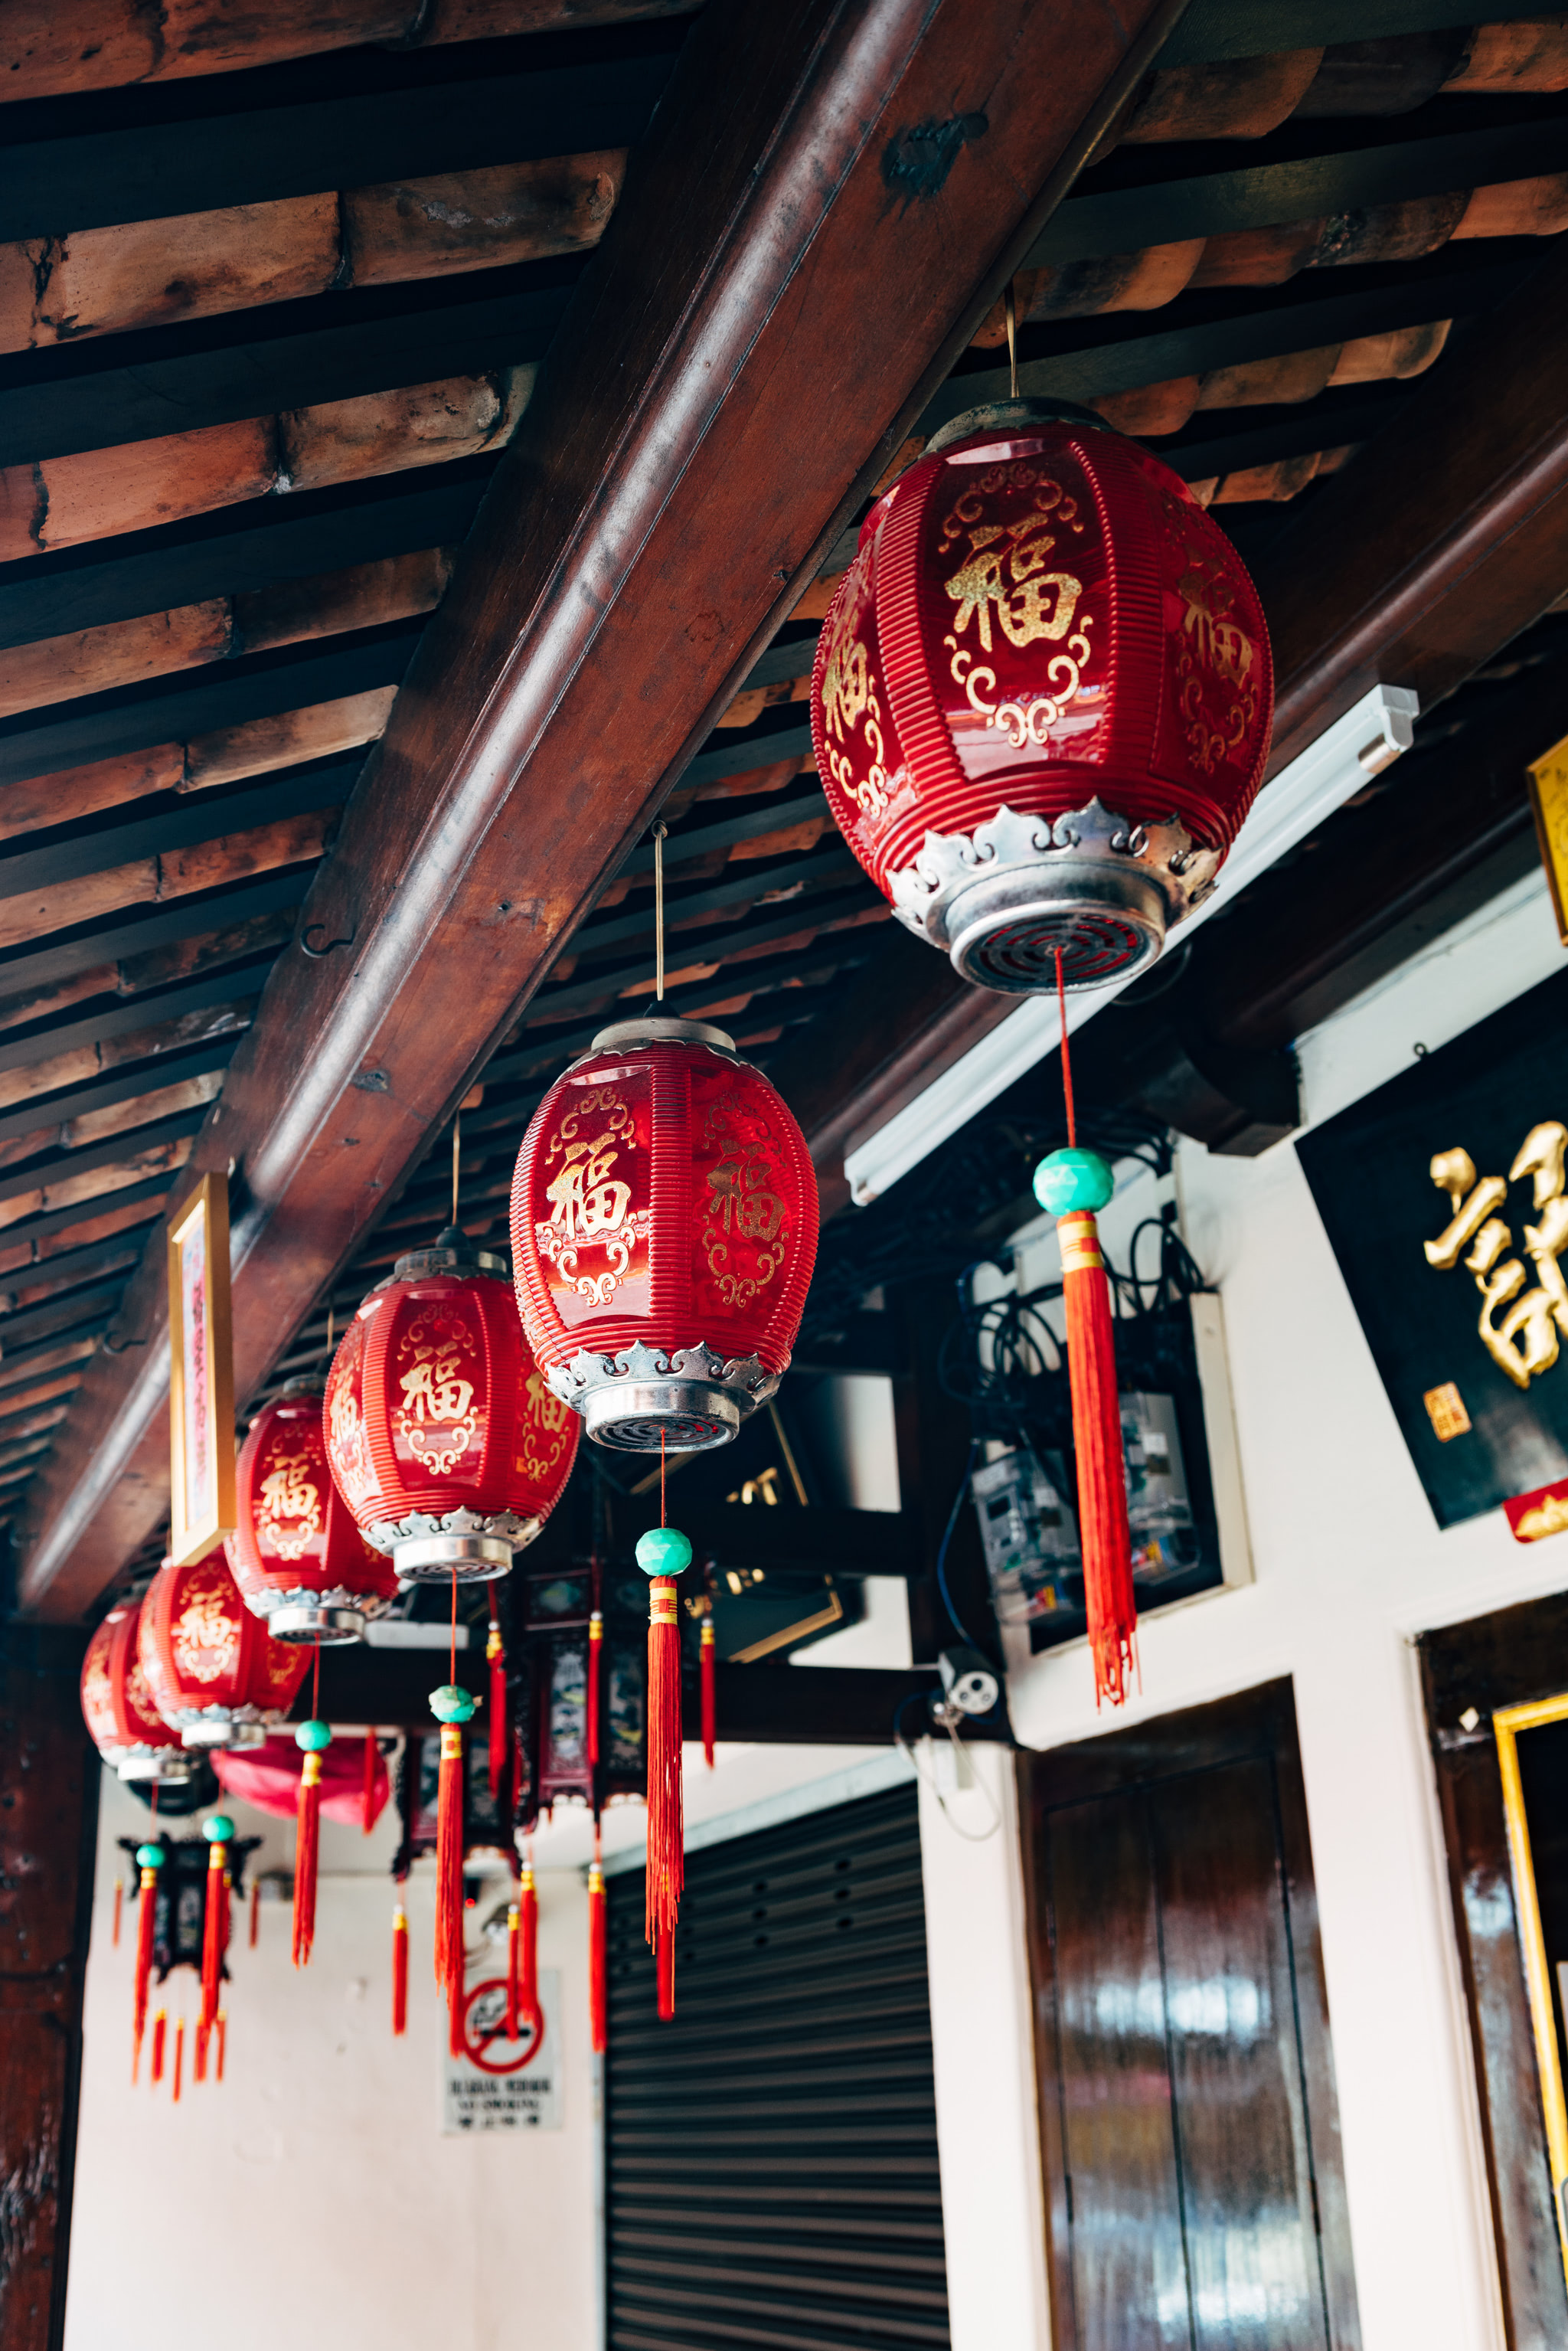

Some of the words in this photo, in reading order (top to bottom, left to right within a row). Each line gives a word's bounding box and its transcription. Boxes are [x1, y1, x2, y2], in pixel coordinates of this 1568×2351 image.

[944, 512, 1082, 652] 福
[1178, 545, 1253, 689] 福
[547, 1133, 632, 1239] 福
[707, 1140, 786, 1241] 福
[399, 1341, 474, 1422] 福
[260, 1453, 318, 1519] 福
[180, 1590, 233, 1648] 福
